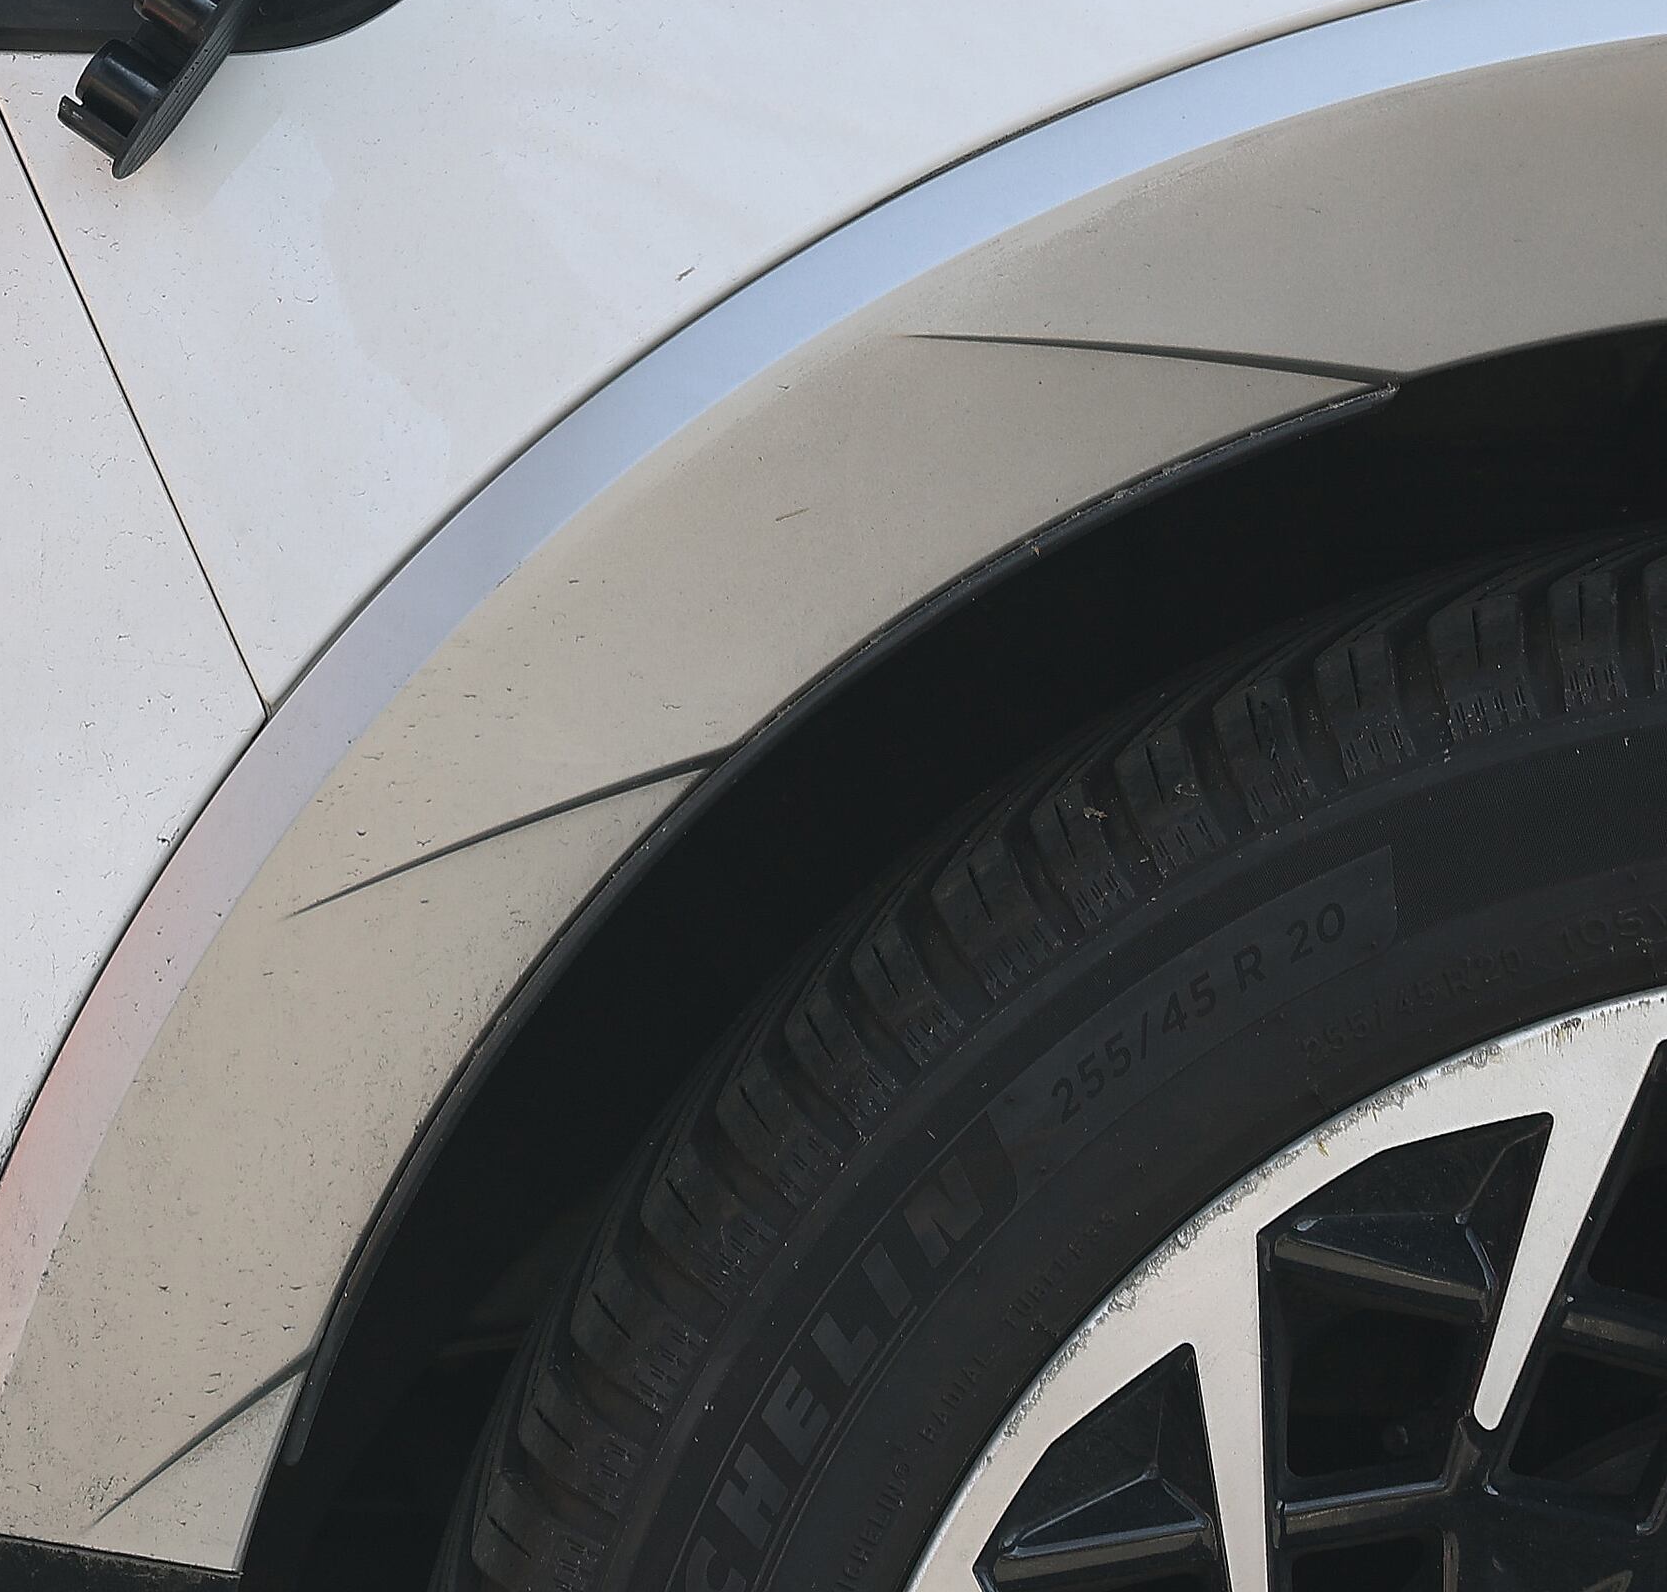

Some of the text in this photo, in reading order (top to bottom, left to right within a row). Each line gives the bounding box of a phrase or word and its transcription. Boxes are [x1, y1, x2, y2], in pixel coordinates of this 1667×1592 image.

[1050, 902, 1346, 1125] 255/45 R 20
